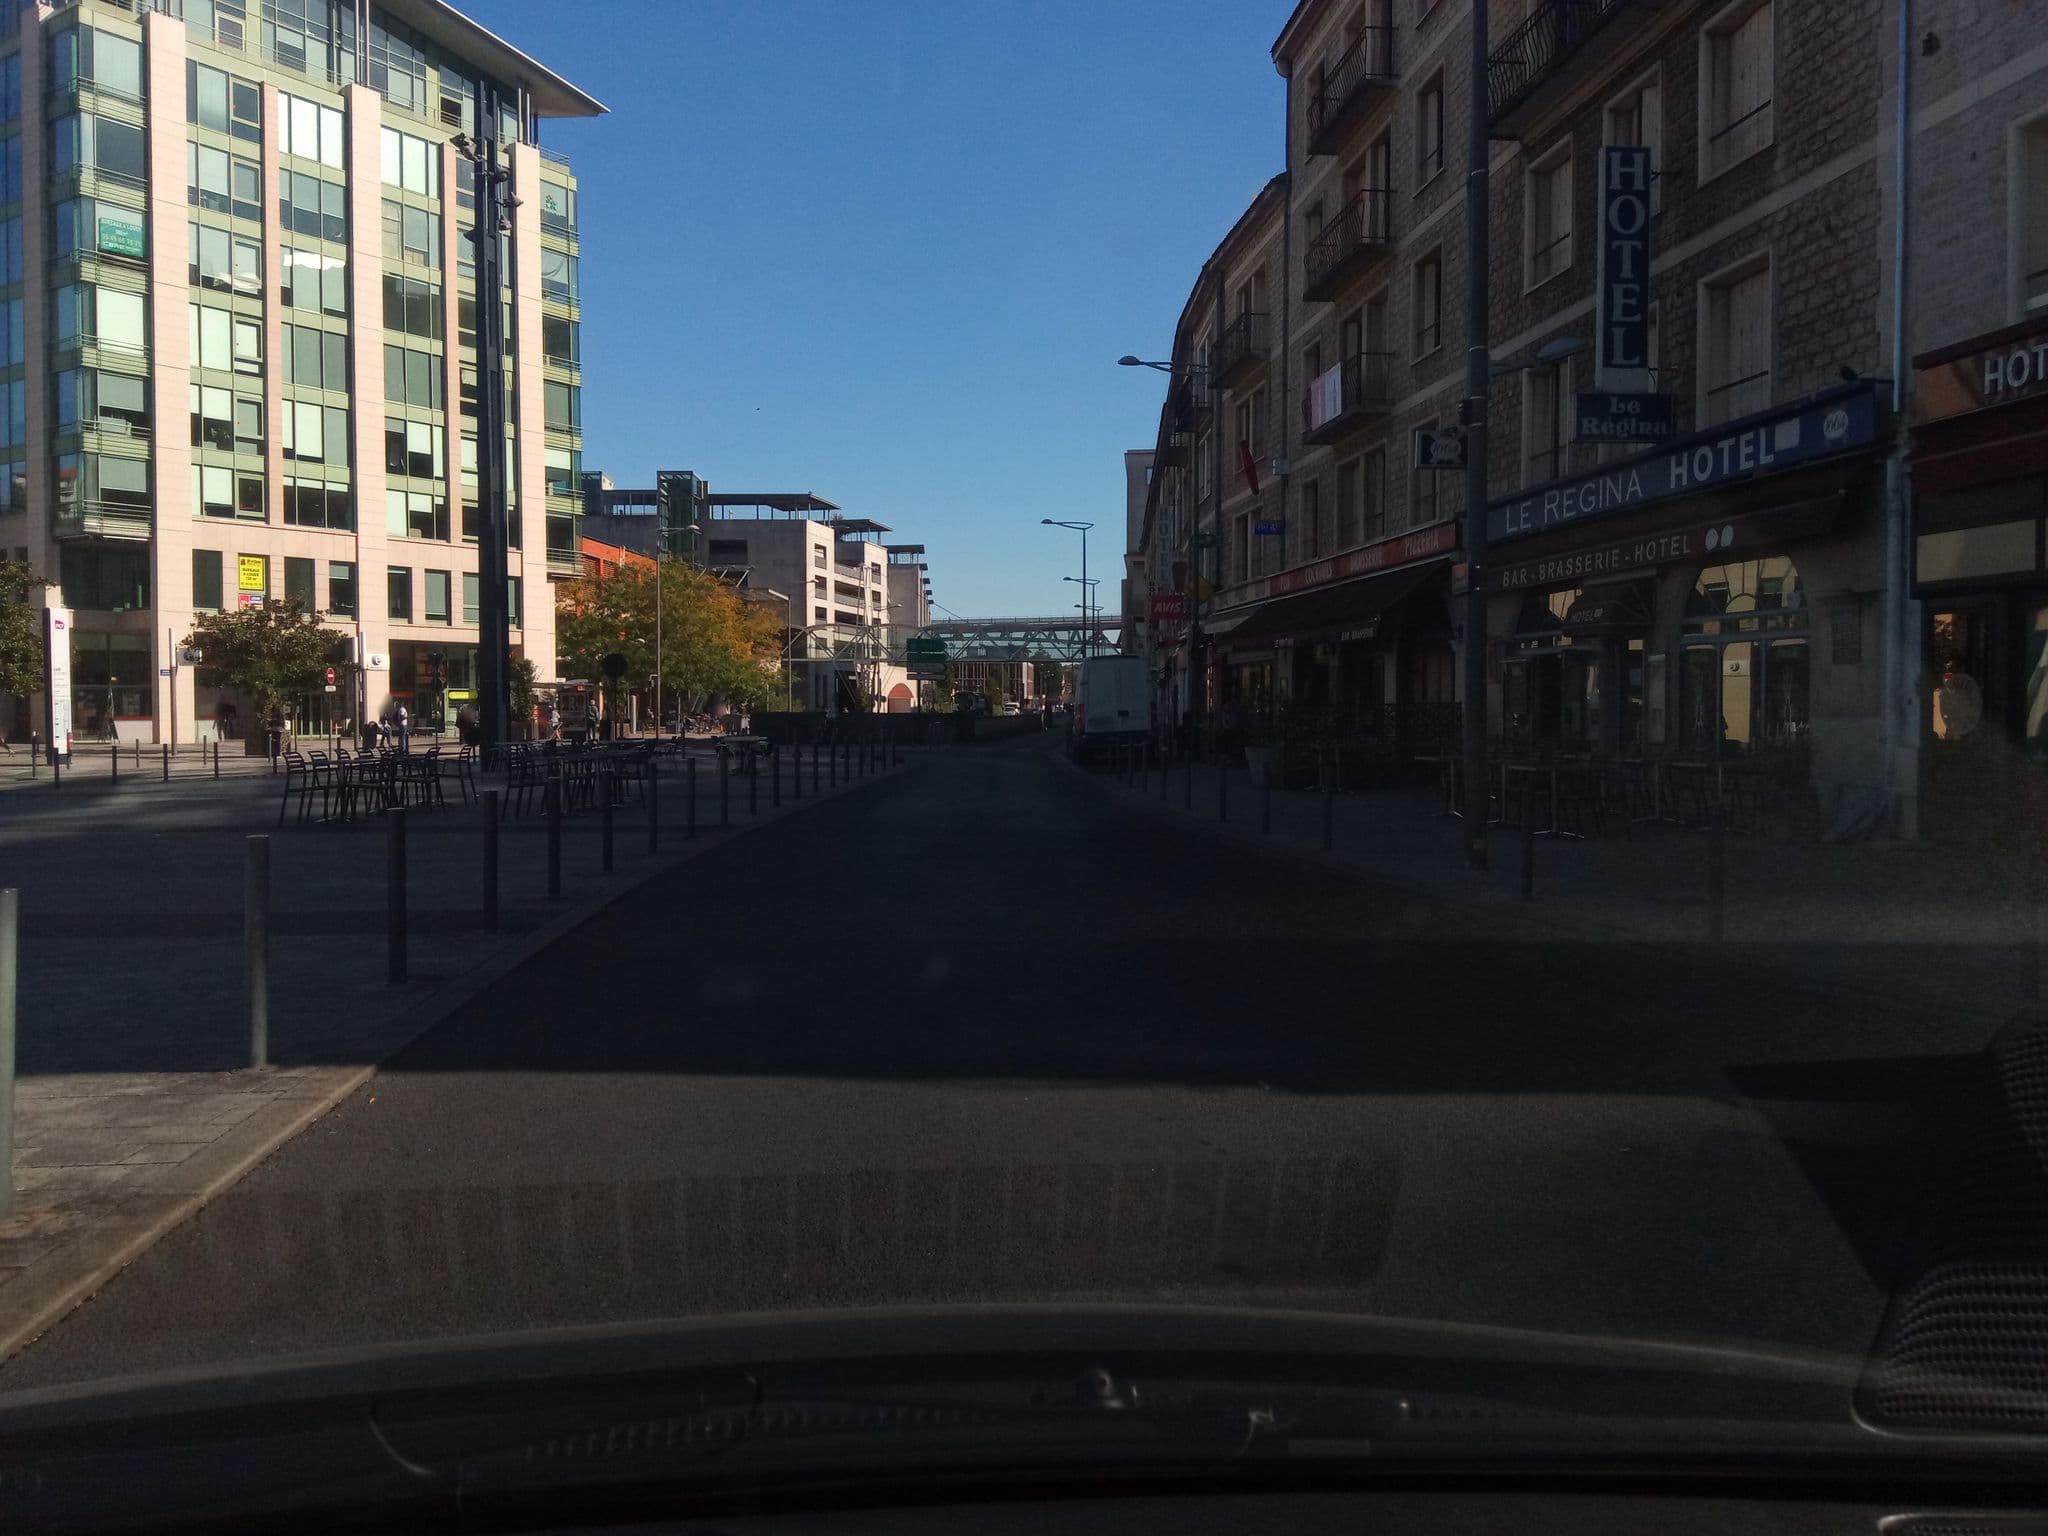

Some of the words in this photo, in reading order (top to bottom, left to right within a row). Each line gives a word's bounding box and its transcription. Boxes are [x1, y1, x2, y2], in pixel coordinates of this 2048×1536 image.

[1608, 151, 1646, 366] HOTEL
[1984, 342, 2048, 395] HOT
[1609, 396, 1641, 414] Le
[1505, 501, 1532, 534] LE
[1543, 468, 1643, 523] REGINA
[1670, 427, 1775, 489] HOTEL
[1159, 507, 1170, 583] HOTEL
[1502, 567, 1528, 588] BAR
[1538, 549, 1621, 581] BRASSERIE
[1634, 535, 1691, 563] HOTEL
[1153, 602, 1181, 614] AVIS
